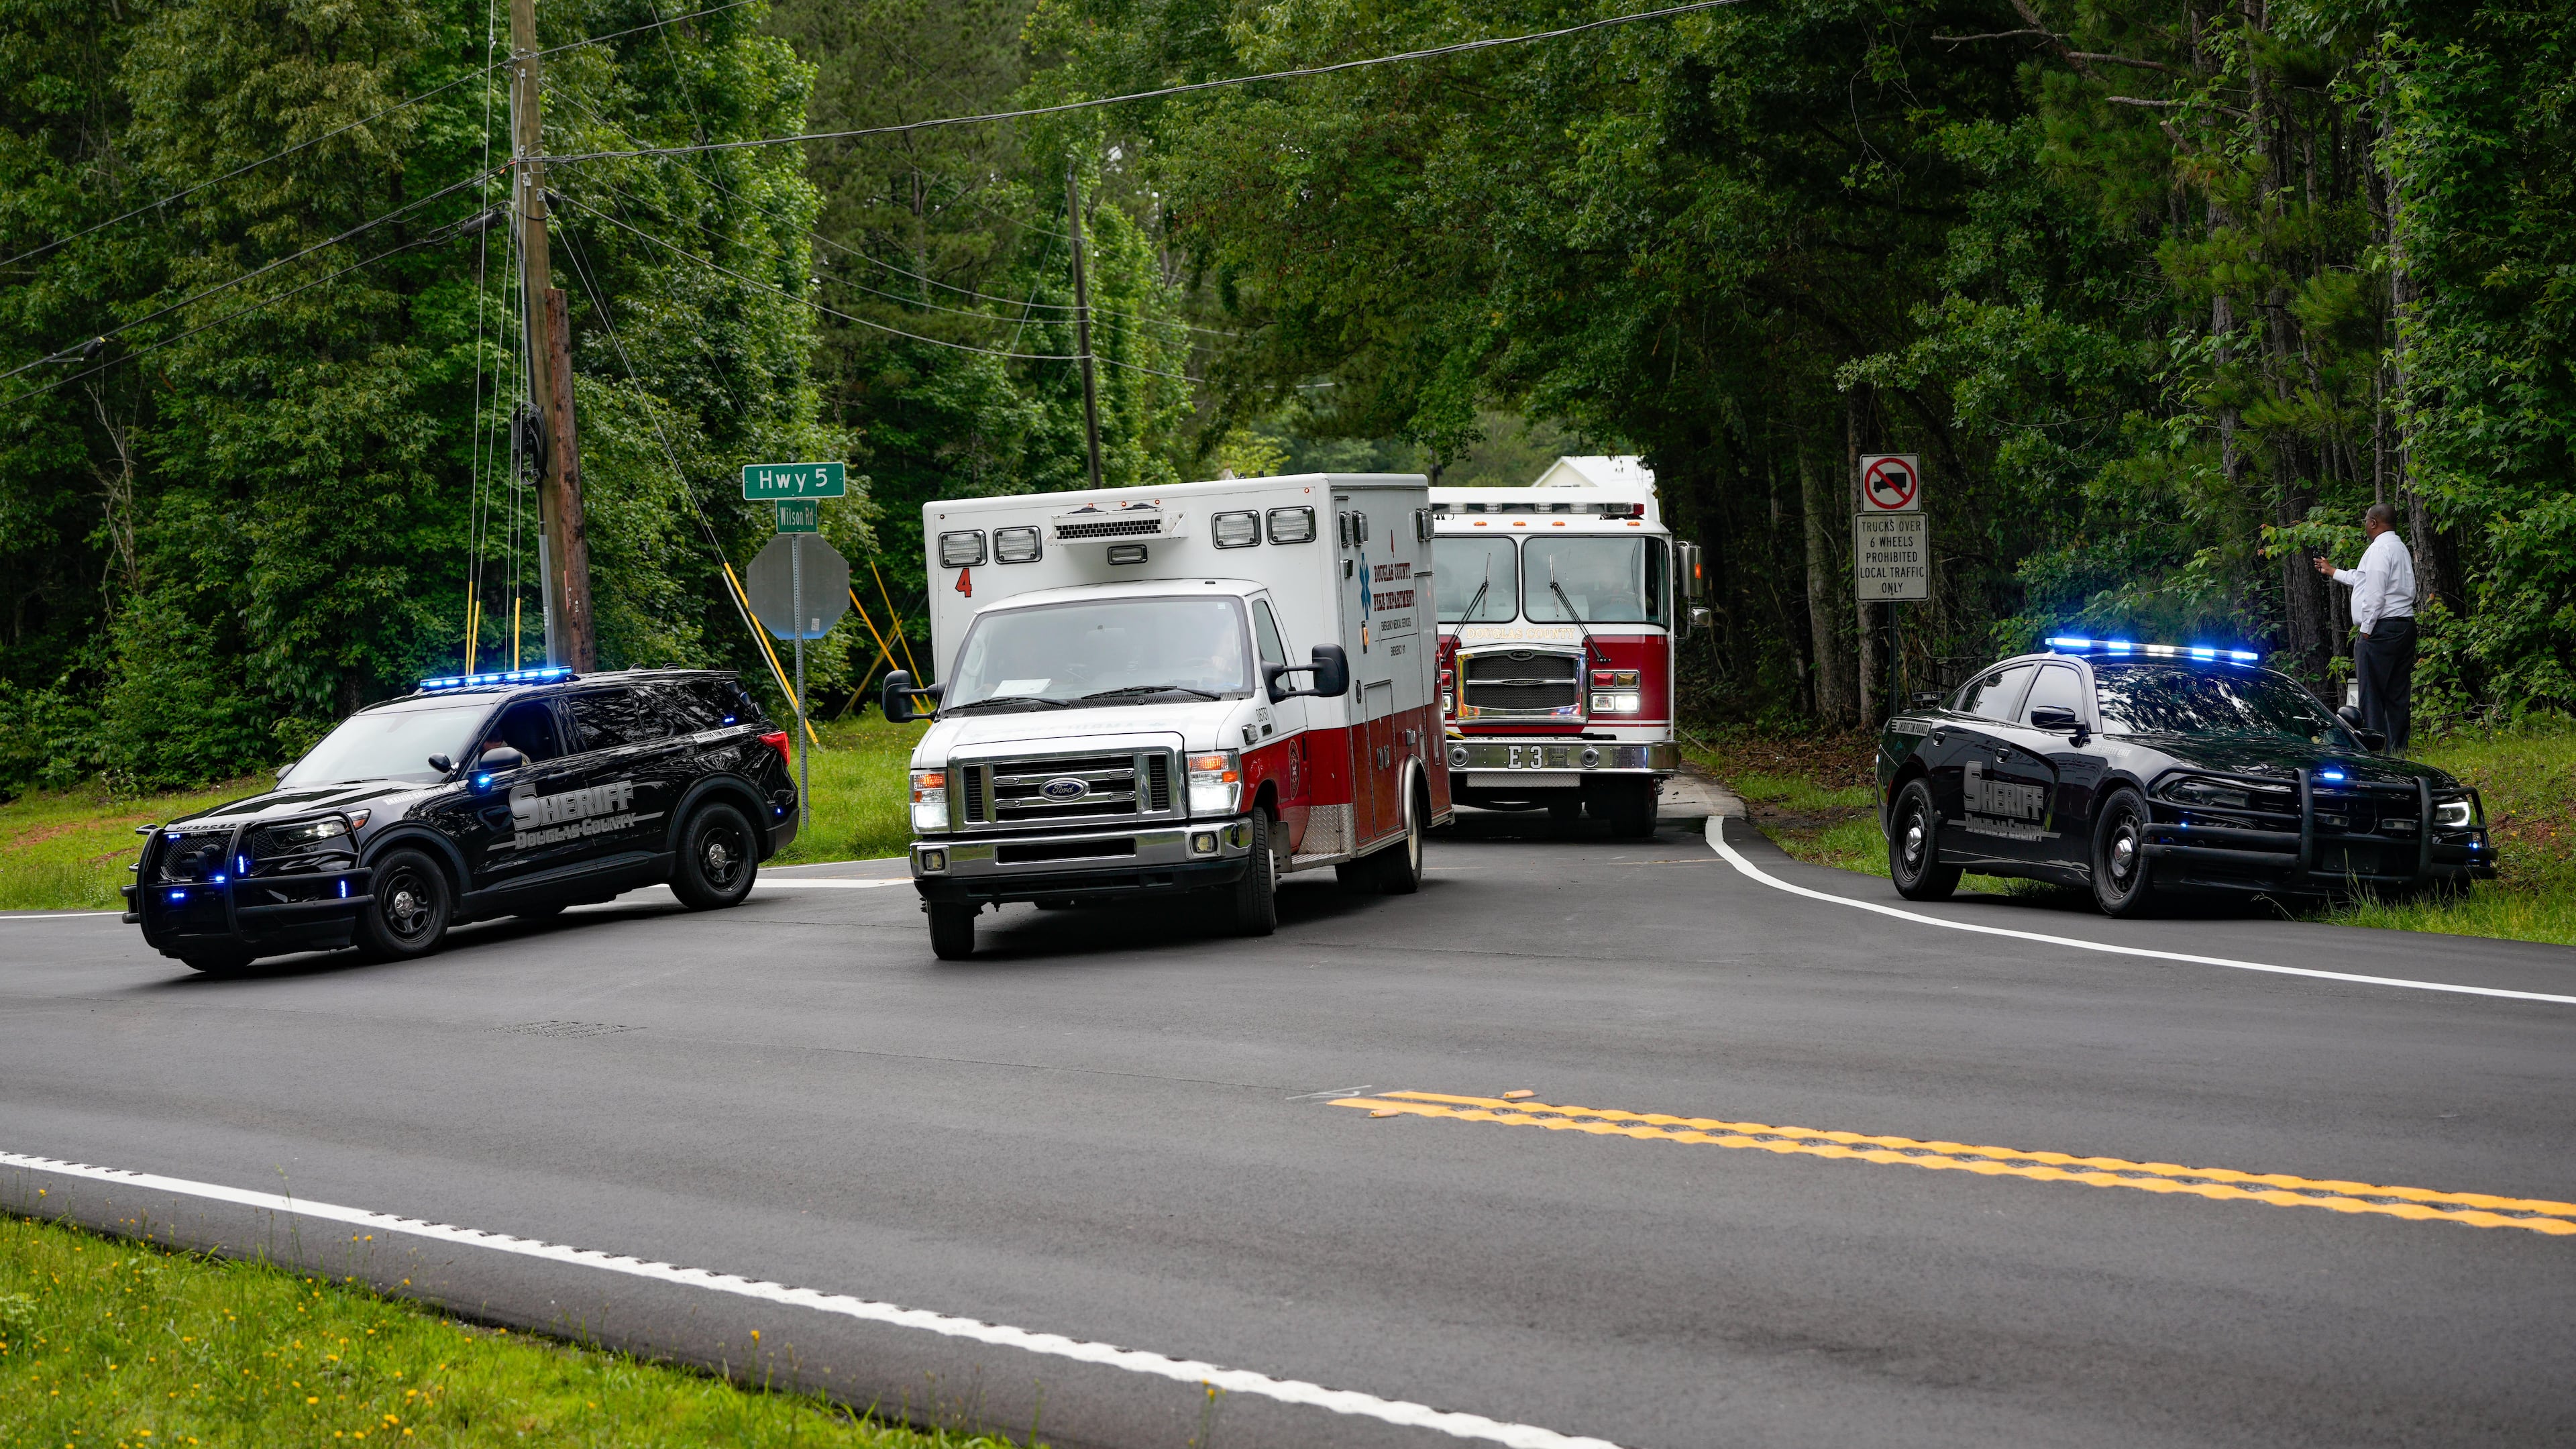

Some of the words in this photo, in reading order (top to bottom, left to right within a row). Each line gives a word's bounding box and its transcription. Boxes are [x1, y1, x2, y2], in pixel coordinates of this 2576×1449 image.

[759, 470, 806, 493] Hwy
[815, 468, 828, 488] 5
[780, 507, 804, 526] Wilson
[805, 506, 814, 526] Rd
[1862, 521, 1894, 532] TRUCKS
[1899, 521, 1921, 531] OVER
[1870, 537, 1875, 547] 6
[1879, 537, 1913, 547] WHEELS
[1866, 551, 1917, 563] PROHIBITED
[1374, 564, 1394, 583] DOUGLAS
[1395, 563, 1411, 580] COUNTY
[1860, 568, 1886, 578] LOCAL
[1890, 567, 1924, 578] TRAFFIC
[955, 568, 972, 598] 4
[1882, 582, 1903, 594] ONLY
[1373, 593, 1385, 611] FIRE
[1386, 590, 1415, 610] DEPARTMENT
[1466, 628, 1523, 639] DOUGLAS
[1526, 628, 1575, 639] COUNTY
[1507, 745, 1522, 769] E
[1529, 745, 1542, 769] 3
[2082, 743, 2100, 753] TRAFFIC
[382, 794, 414, 805] TRAFFIC
[413, 788, 438, 799] SAFETY
[1052, 784, 1074, 794] Ford
[1964, 761, 2043, 820] SHERIFF
[509, 780, 634, 830] SHERIFF
[515, 823, 580, 849] DOUGLAS
[581, 812, 637, 836] COUNTY
[1965, 813, 2007, 837] DOUGLAS
[2008, 819, 2044, 842] COUNTY
